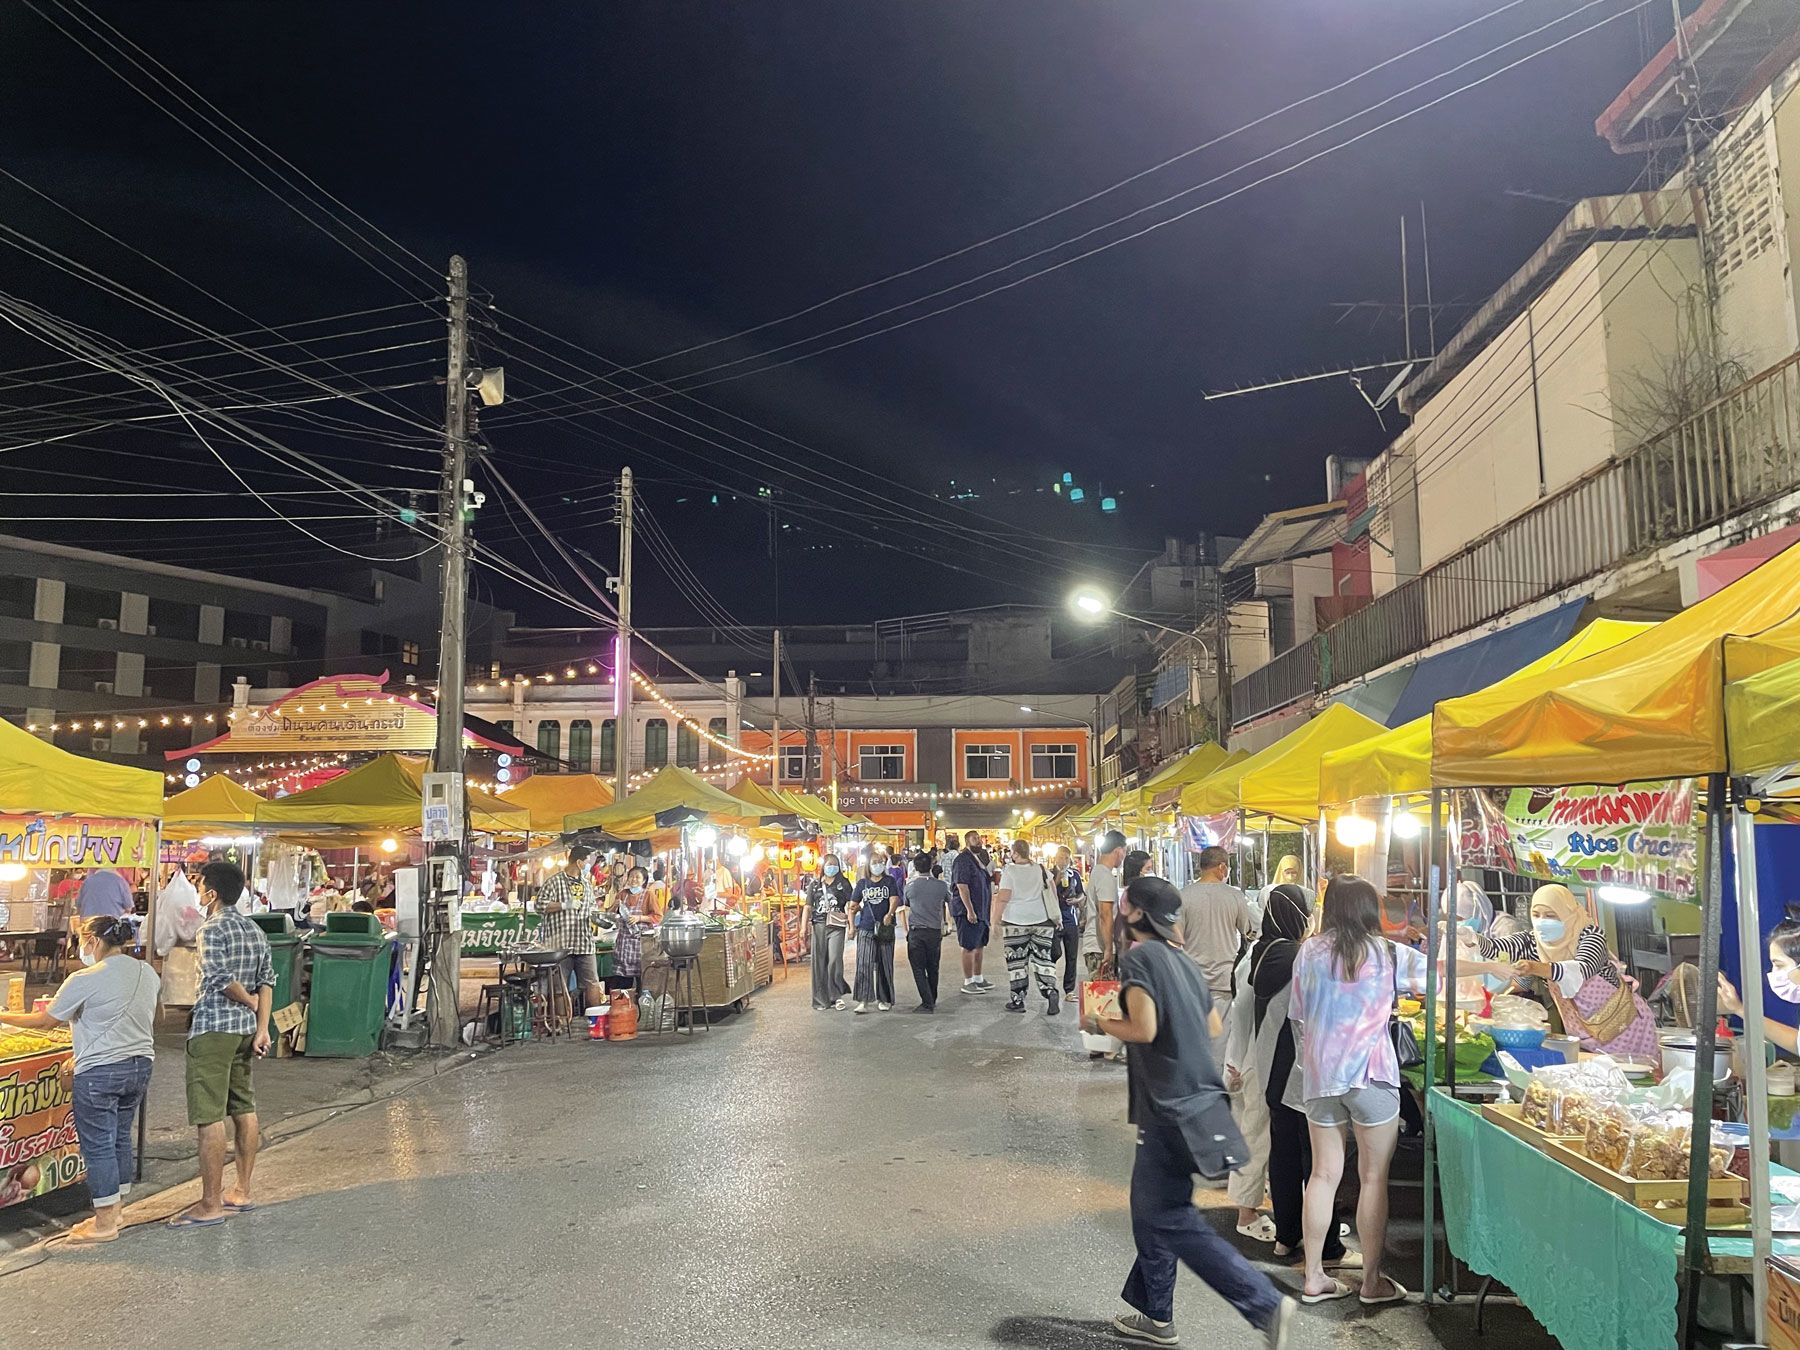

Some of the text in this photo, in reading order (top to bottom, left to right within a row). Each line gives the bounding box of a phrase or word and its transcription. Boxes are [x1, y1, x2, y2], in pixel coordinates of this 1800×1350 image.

[819, 794, 914, 808] Ornge tree house
[1567, 831, 1694, 858] Rice Crac
